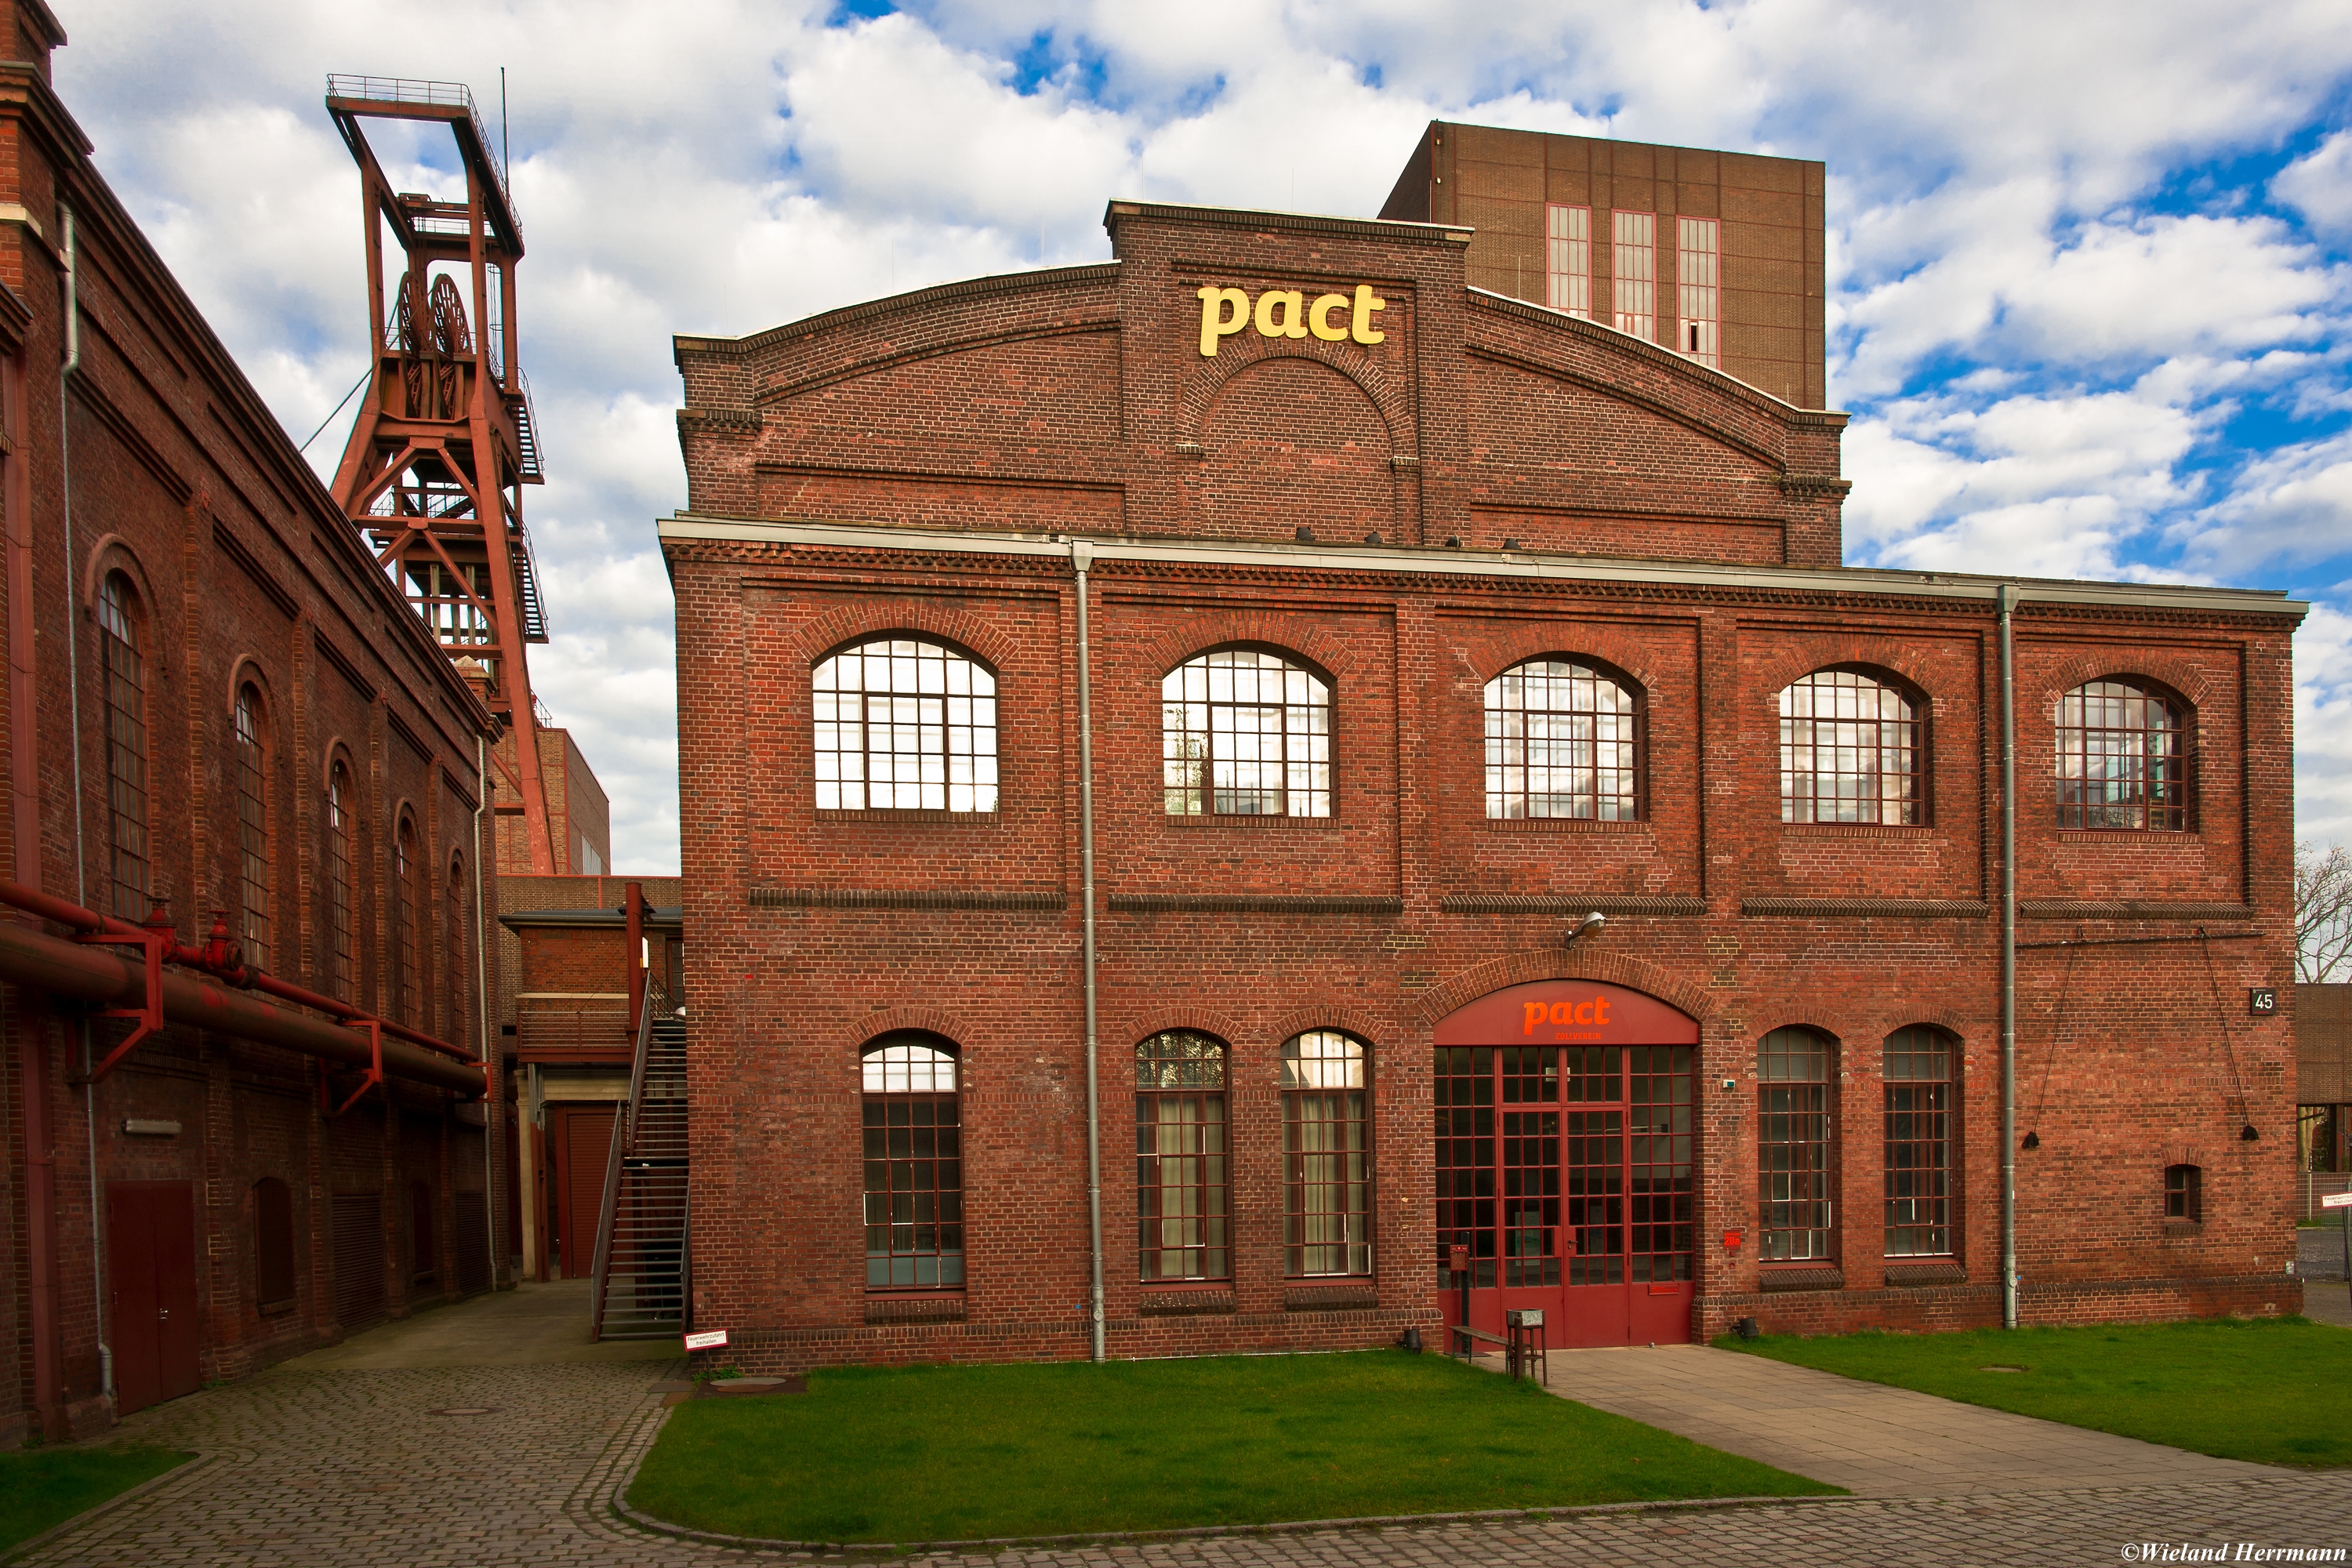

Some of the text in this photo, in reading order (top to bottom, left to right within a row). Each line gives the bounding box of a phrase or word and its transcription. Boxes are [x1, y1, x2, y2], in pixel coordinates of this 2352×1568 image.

[1197, 284, 1386, 357] pact
[2255, 994, 2273, 1009] 45
[1523, 996, 1610, 1036] pact
[1724, 1236, 1740, 1246] 20a
[688, 1332, 724, 1341] Feuerwehrzufahrt
